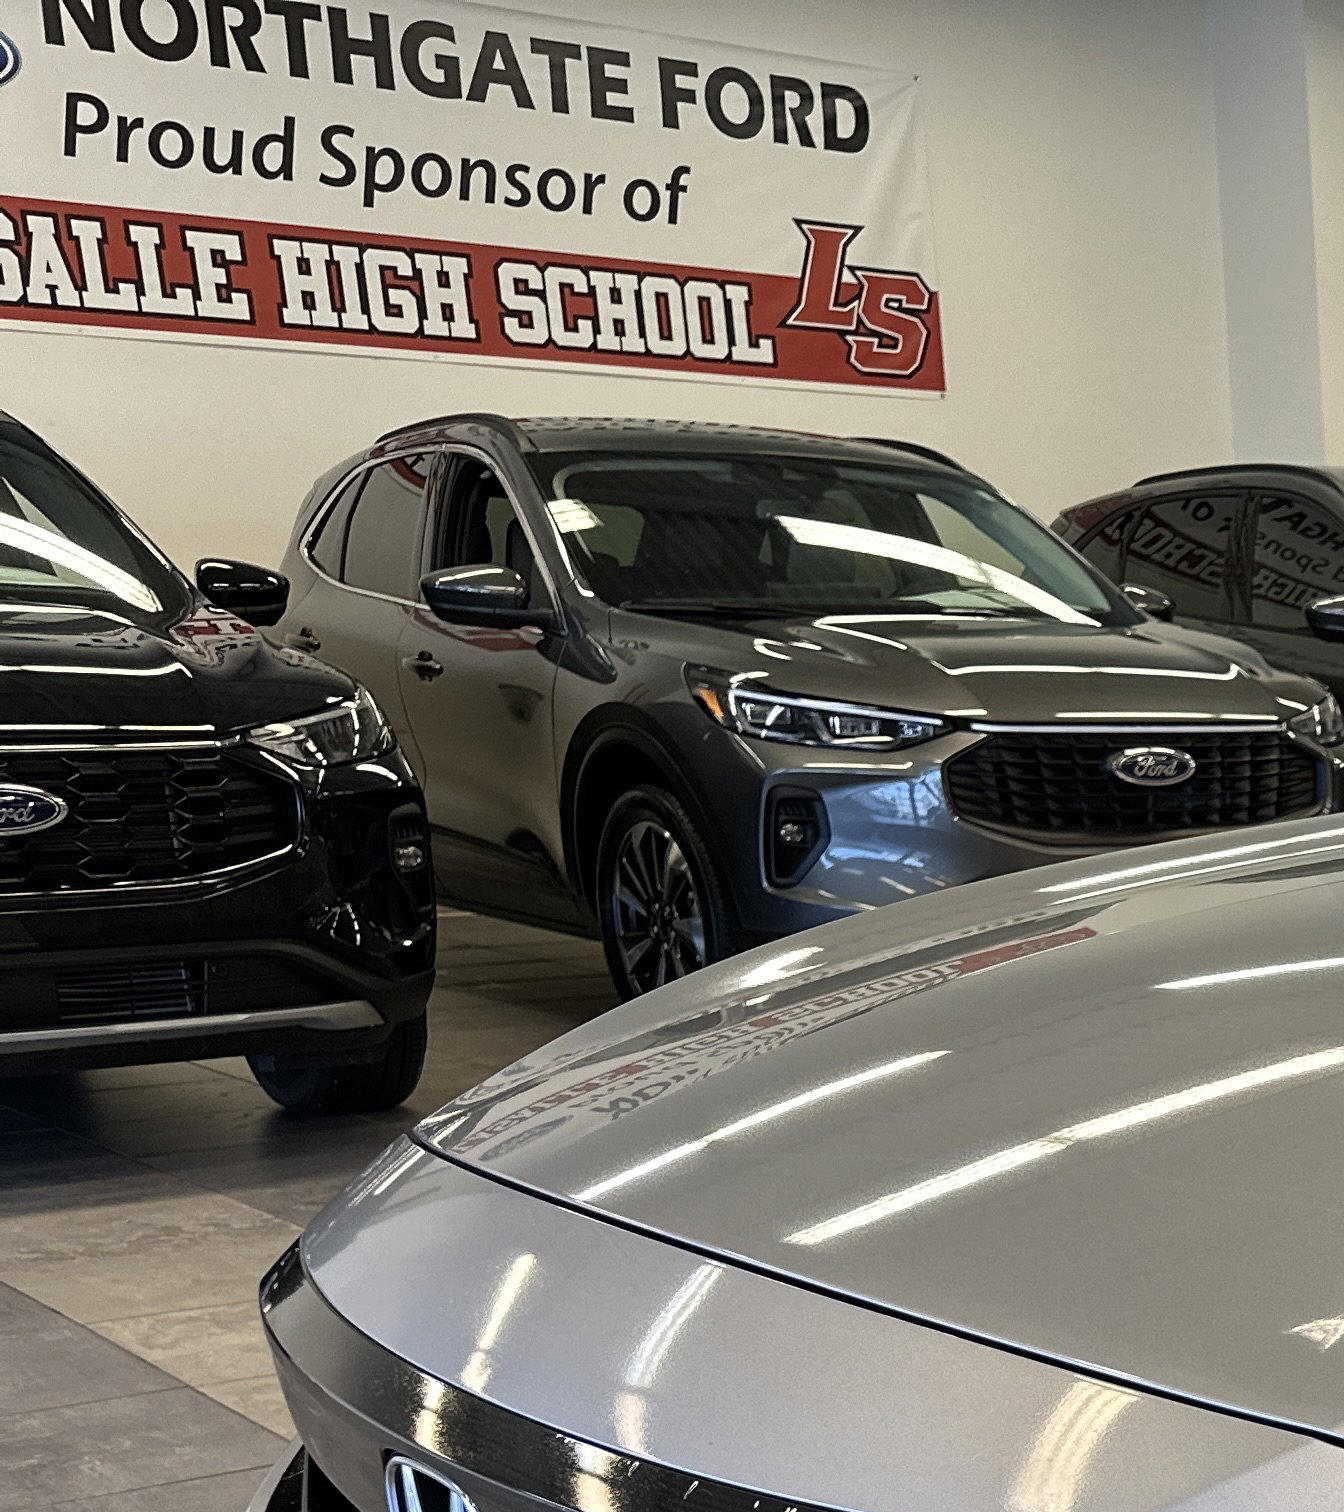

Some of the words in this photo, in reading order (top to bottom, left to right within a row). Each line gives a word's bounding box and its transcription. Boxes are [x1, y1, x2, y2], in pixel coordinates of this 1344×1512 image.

[40, 0, 635, 124] NORTHGATE
[658, 58, 870, 154] FORD
[63, 91, 296, 182] Proud
[319, 125, 607, 215] Sponsor
[622, 165, 690, 225] of
[272, 236, 477, 341] HIGH
[495, 262, 775, 366] SCHOOL
[1133, 755, 1179, 777] Ford
